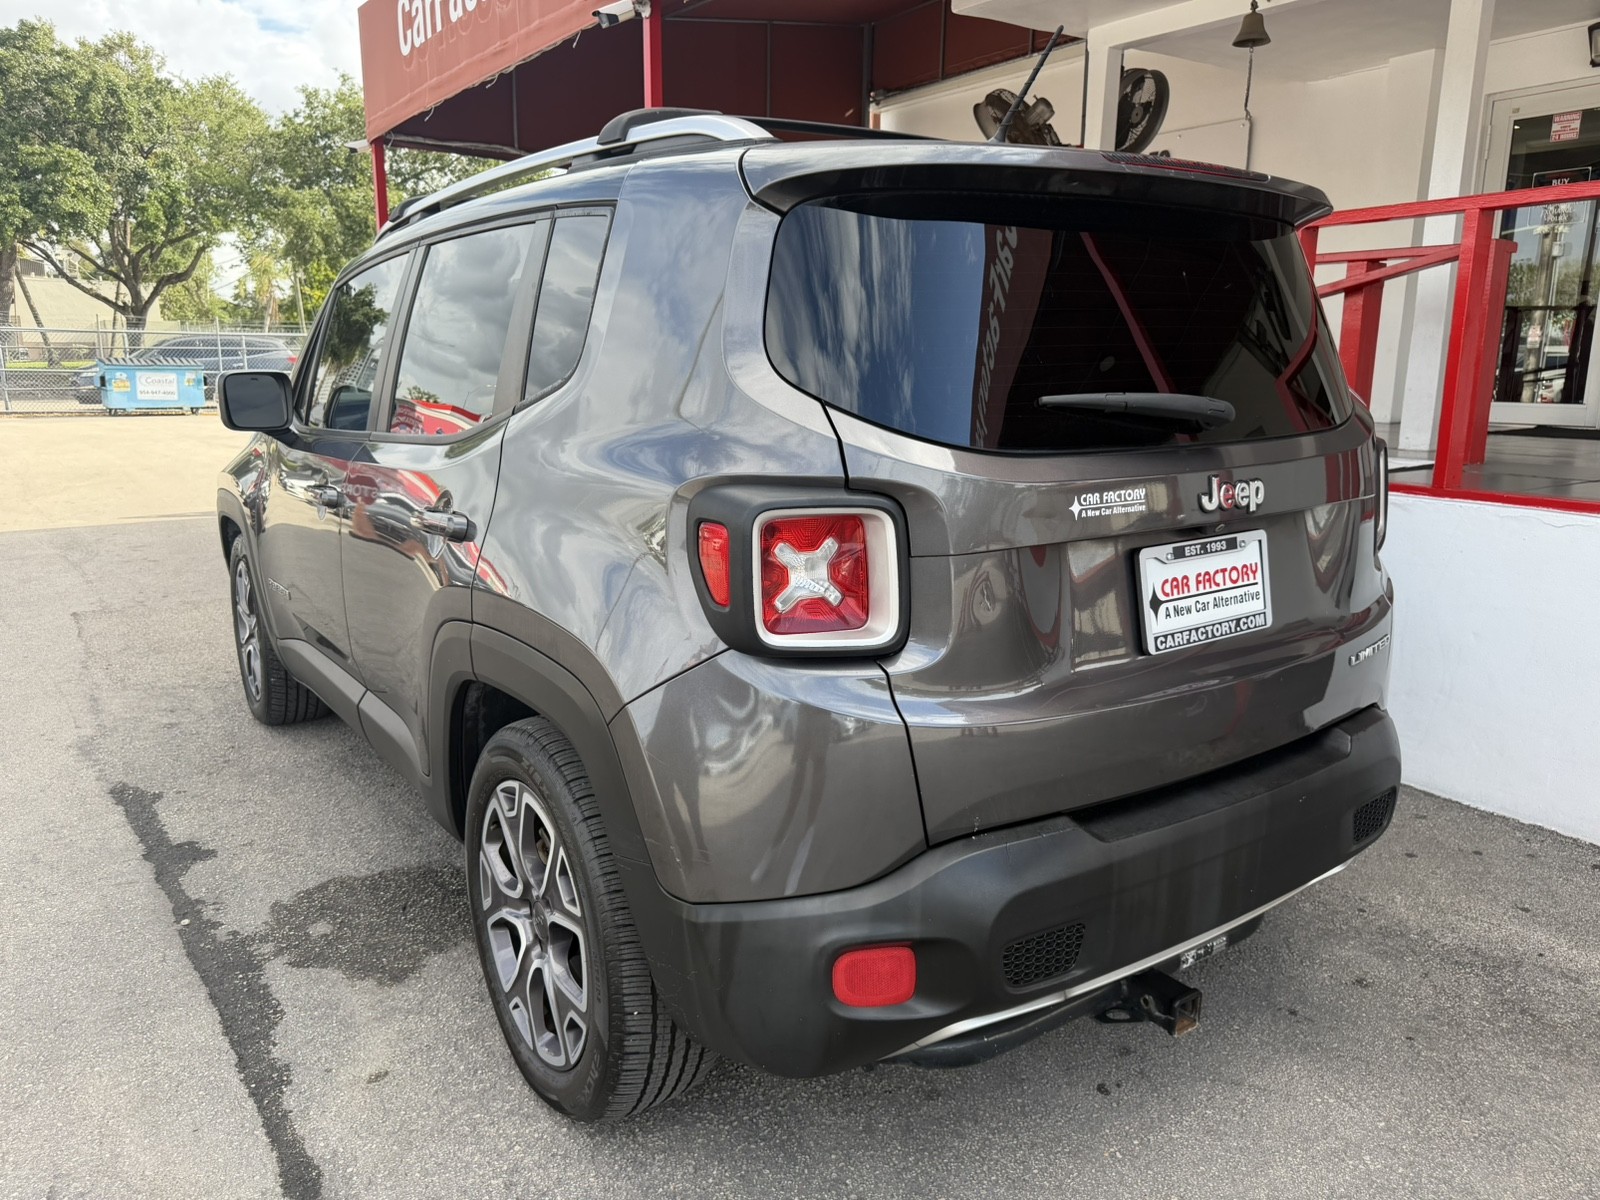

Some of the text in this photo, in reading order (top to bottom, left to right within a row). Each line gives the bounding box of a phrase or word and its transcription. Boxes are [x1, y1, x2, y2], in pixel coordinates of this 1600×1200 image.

[1552, 178, 1570, 186] BUY
[144, 376, 175, 385] Coastal
[1081, 488, 1146, 506] CAR FACTORY
[1200, 474, 1265, 512] Jeep
[1081, 503, 1146, 518] A New Car Alternative
[1184, 541, 1227, 556] EST. 1993
[1161, 562, 1258, 597] CAR FACTORY
[1165, 590, 1261, 620] A New Car Alternative
[1156, 613, 1266, 650] CARFACTORY.COM
[1349, 634, 1390, 666] LIMITED
